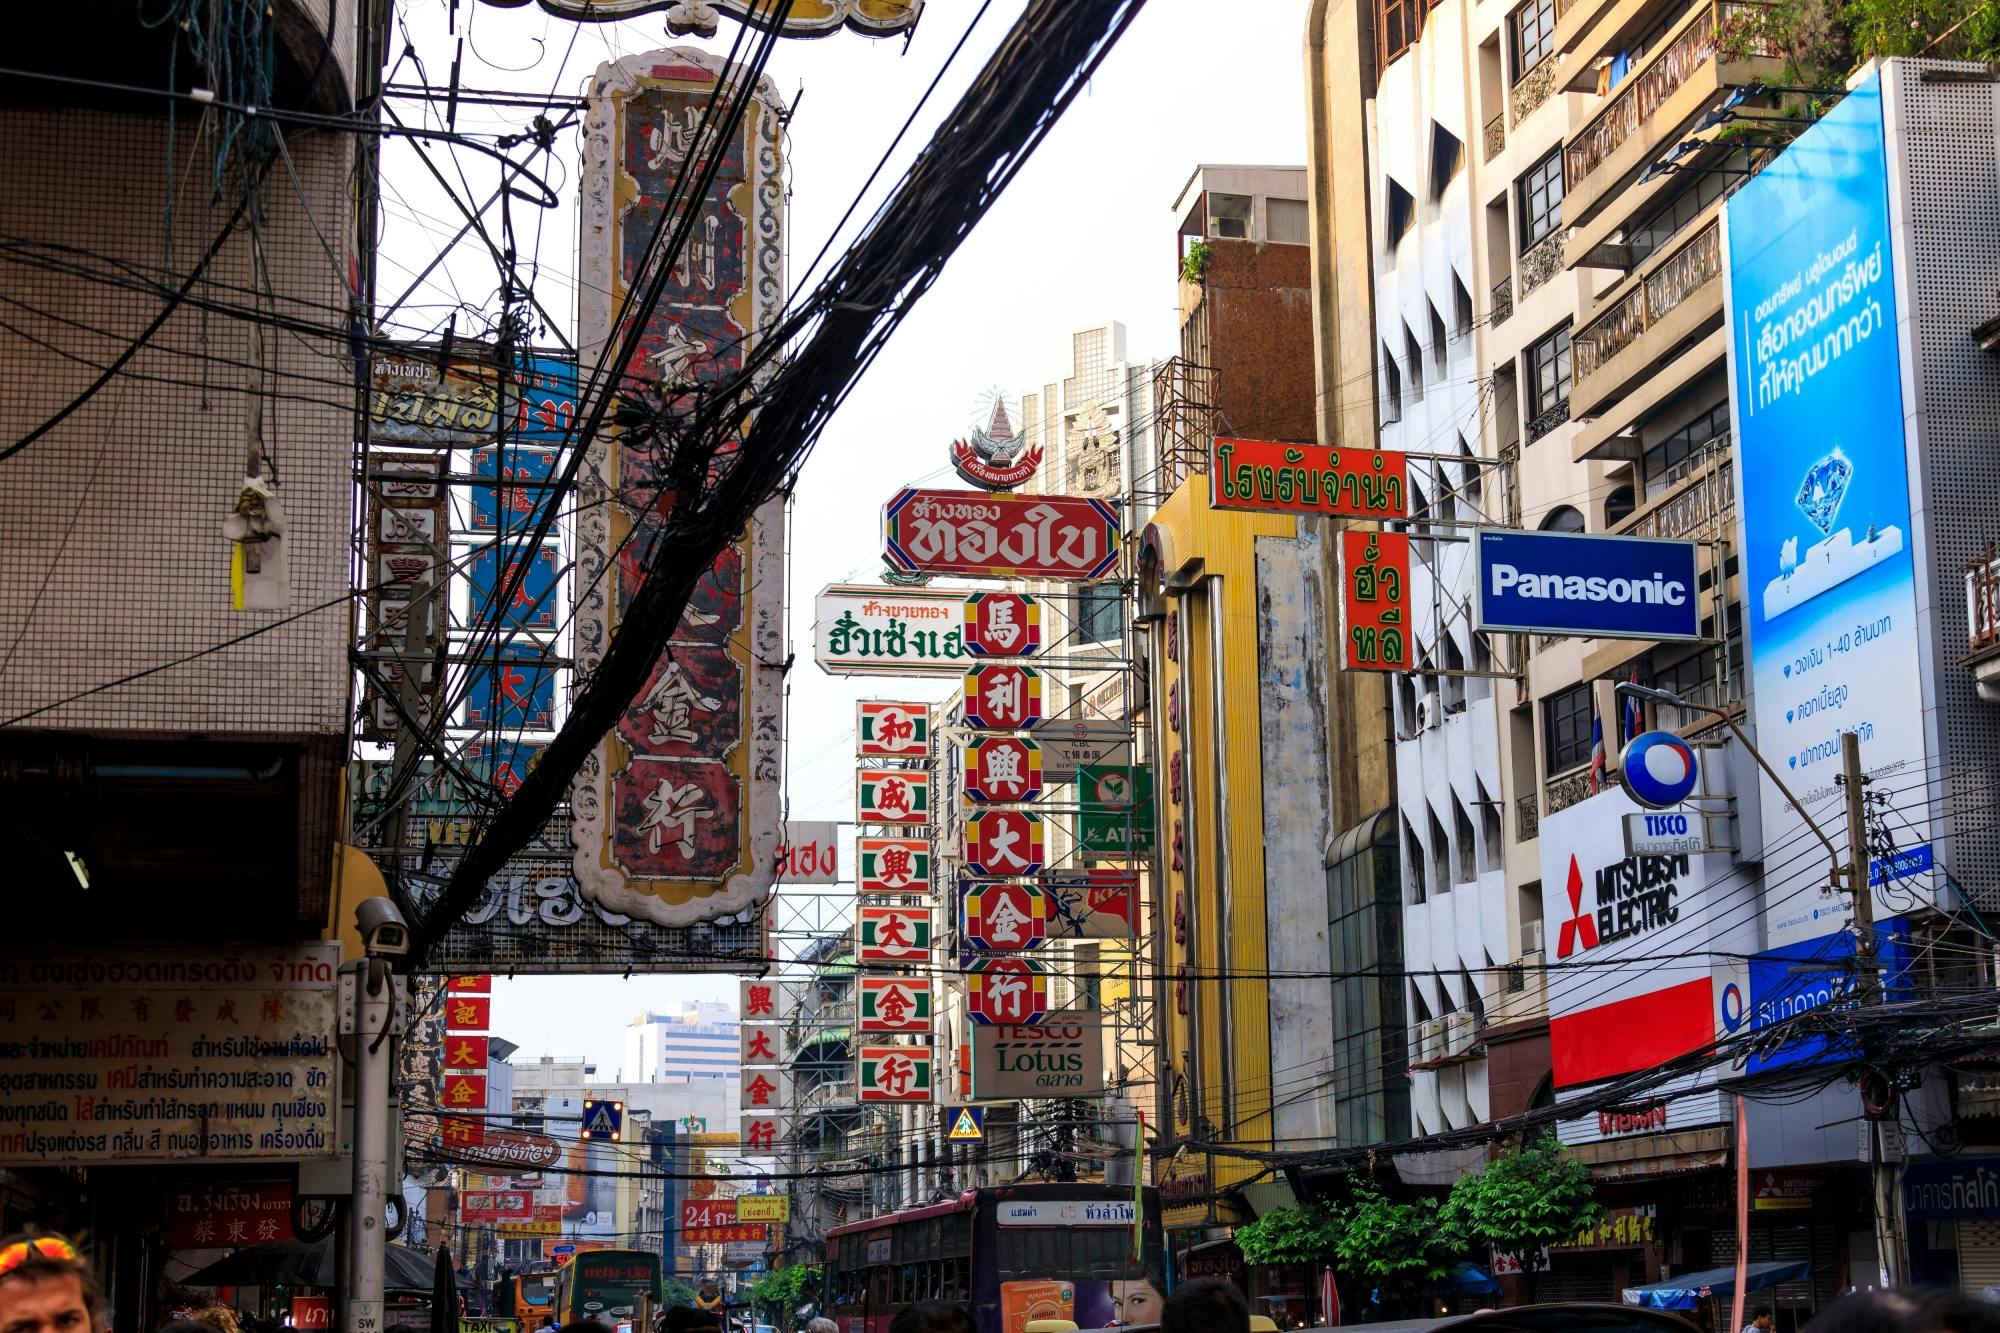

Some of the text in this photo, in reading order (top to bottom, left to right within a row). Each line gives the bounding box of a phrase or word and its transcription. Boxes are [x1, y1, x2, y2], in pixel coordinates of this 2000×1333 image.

[1757, 240, 1881, 365] เลือกออมทรัพย์
[1759, 296, 1881, 409] ที่ให้คุณมากกว่า
[1217, 443, 1403, 510] โรงรับจำนำ
[911, 496, 1001, 520] ห้างทอง
[908, 503, 1098, 568] ทองใบ
[1491, 562, 1687, 606] Panasonic
[862, 600, 949, 619] ห้างขายทอง
[1794, 613, 1893, 677] วงเงิน 1-40 ล้านบาท
[1797, 684, 1848, 721] ดอกเบี้ยสูง
[984, 599, 1031, 1018] 馬利興大金行
[1645, 814, 1688, 836] TISCO
[1635, 836, 1700, 853] ธนาคารทิสโก้
[1595, 853, 1690, 907] MITSUBISHI
[876, 712, 914, 1095] 和成興大金行
[1597, 883, 1679, 945] ELECTRIC
[269, 956, 333, 983] จำกัด
[997, 1022, 1083, 1039] TESCO
[997, 1049, 1083, 1072] Lotus
[1035, 1074, 1083, 1087] ตลาด
[226, 1103, 265, 1119] แหนม
[112, 1127, 144, 1152] กลิ่น
[150, 1129, 161, 1151] สี
[260, 1124, 325, 1150] เครื่องดื่ม
[1904, 1166, 1999, 1212] นาคารทิสโก้
[685, 1206, 711, 1227] 24
[1085, 1203, 1134, 1221] หัวลำโพ
[193, 1218, 280, 1244] 蔡東發
[357, 1317, 375, 1328] SW
